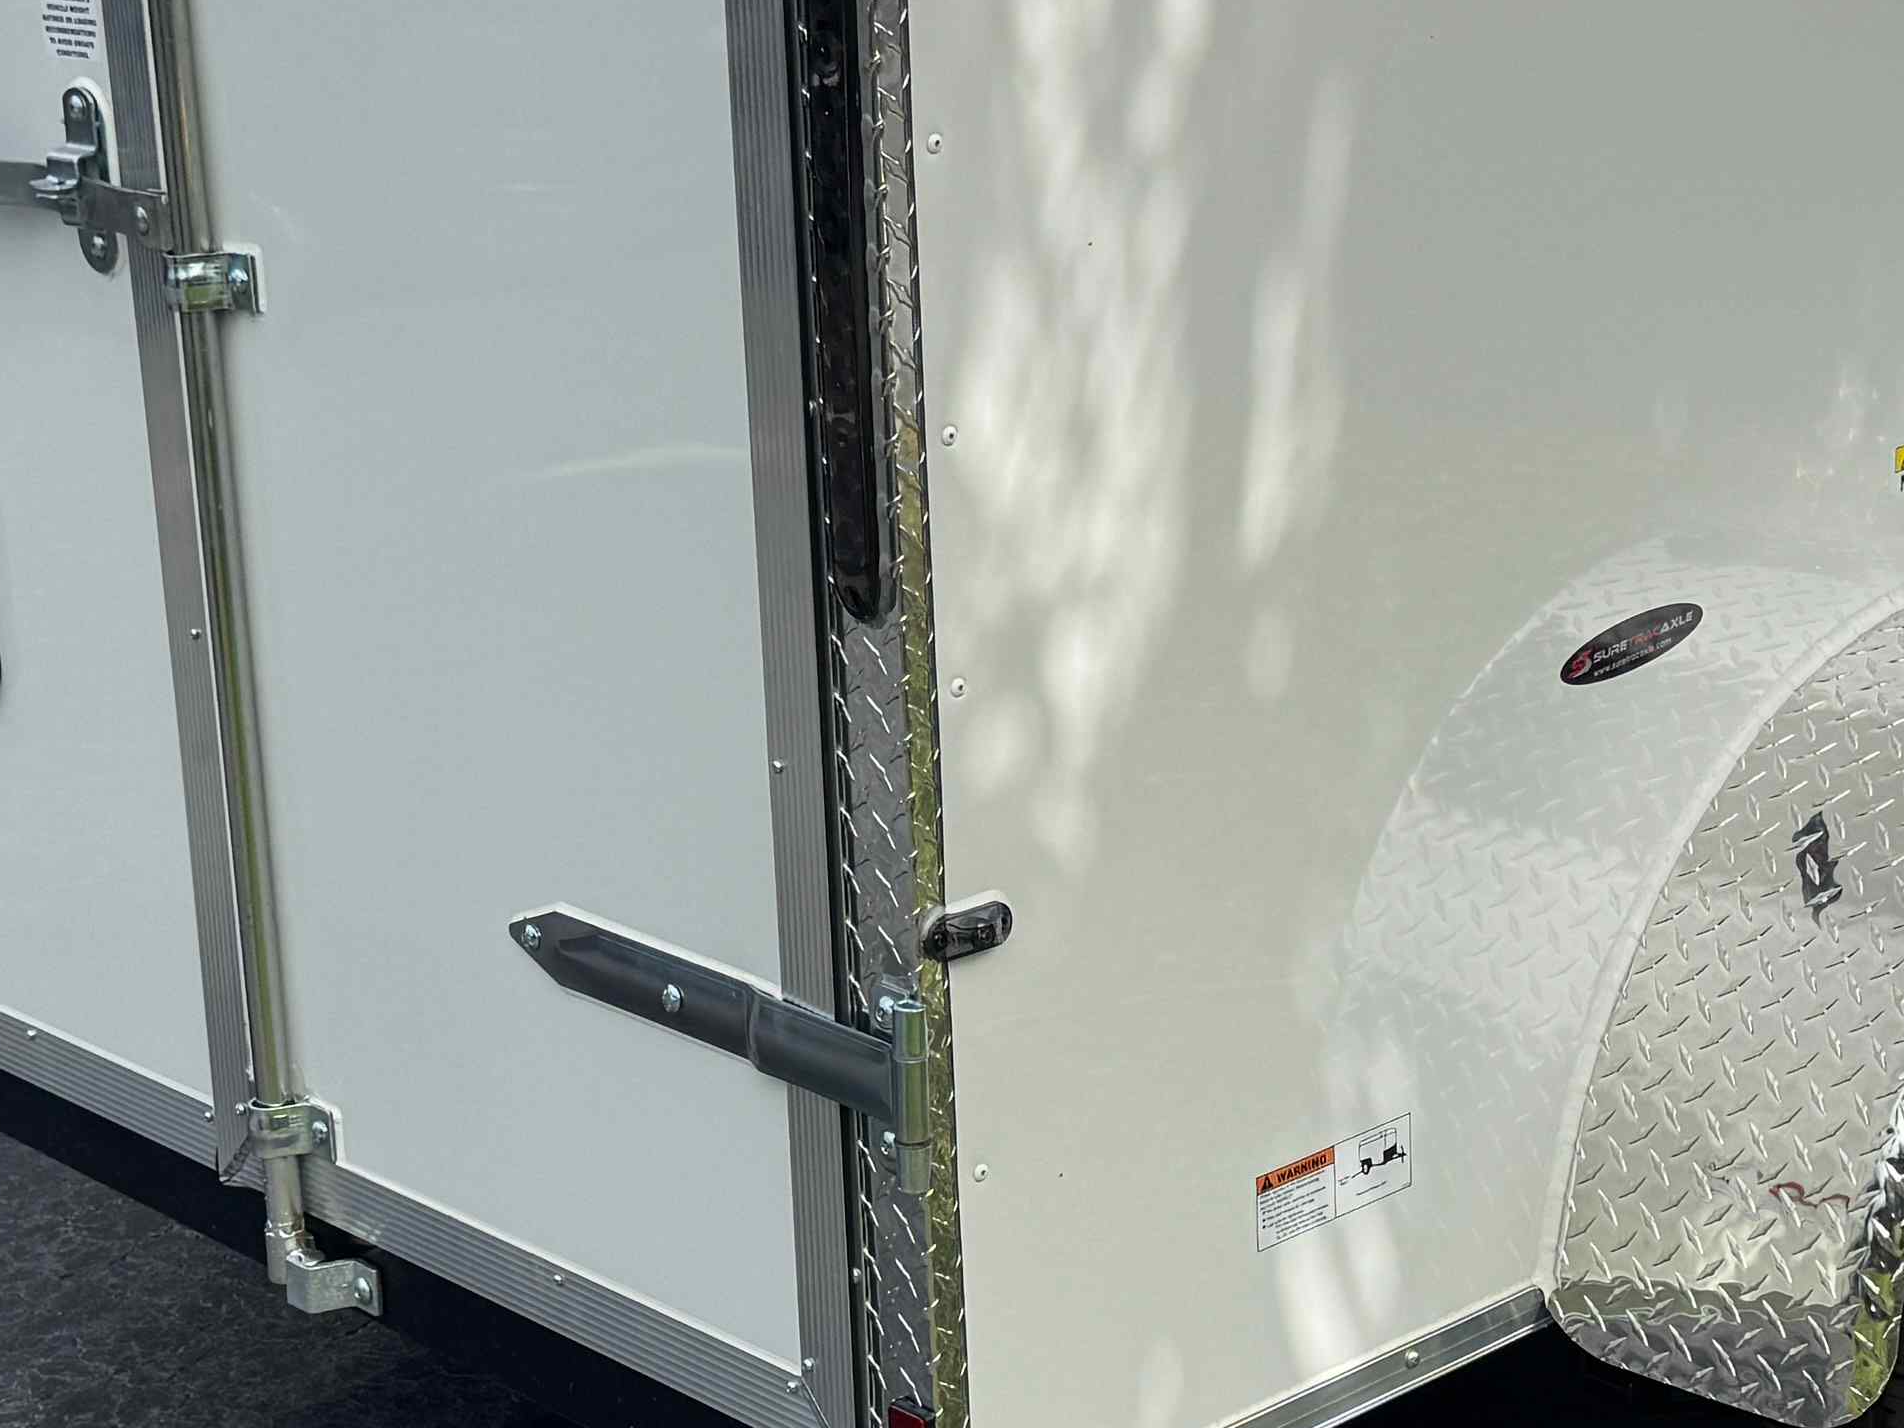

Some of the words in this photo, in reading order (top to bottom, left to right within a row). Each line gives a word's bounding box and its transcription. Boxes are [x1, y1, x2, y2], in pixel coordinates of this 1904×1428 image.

[1593, 639, 1629, 663] SURE
[1660, 610, 1694, 635] AXLE
[1276, 1154, 1327, 1183] WARNING
